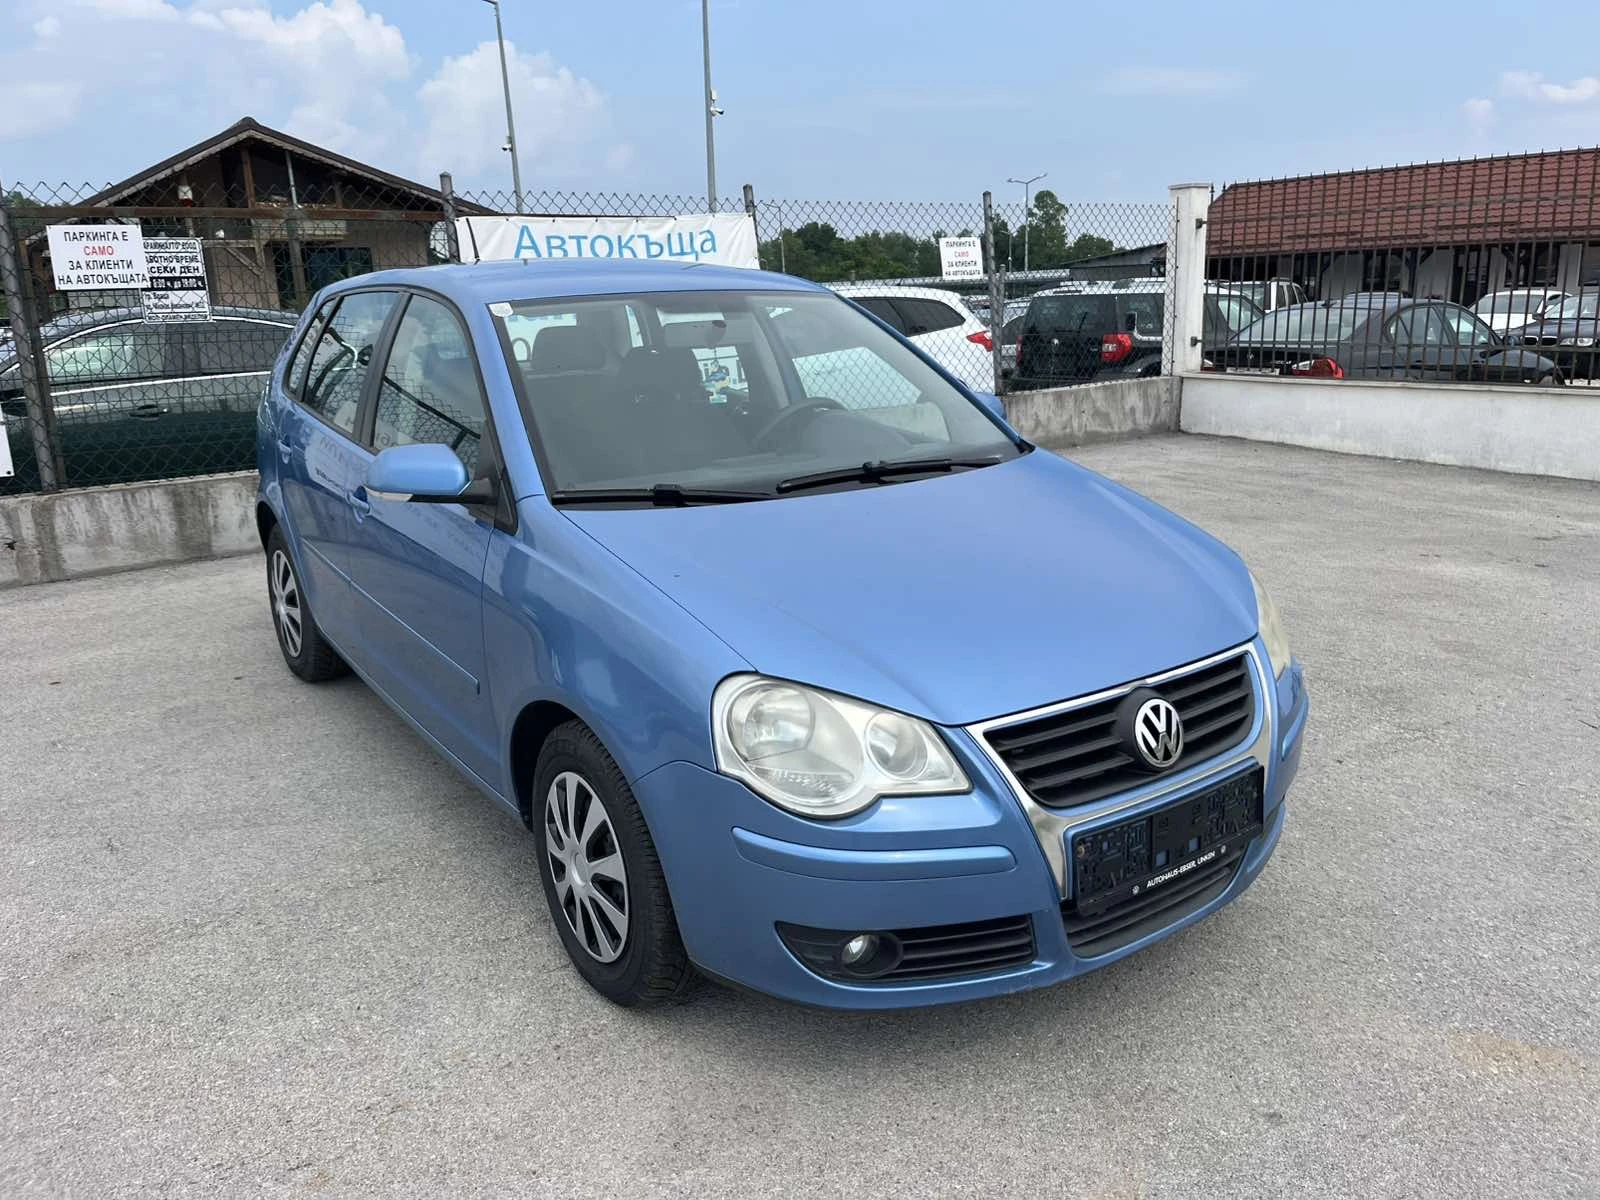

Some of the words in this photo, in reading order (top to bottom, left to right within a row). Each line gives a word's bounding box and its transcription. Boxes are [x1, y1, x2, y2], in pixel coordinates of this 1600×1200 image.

[64, 231, 118, 242] ПАРКИНГА
[122, 231, 129, 241] Е
[513, 224, 718, 261] Автокъща
[945, 240, 972, 248] ПАРКИНГА
[83, 245, 114, 256] САМО
[145, 255, 174, 263] АБОТНО
[69, 260, 83, 271] ЗА
[86, 259, 134, 270] КЛИЕНТИ
[180, 265, 200, 275] ДЕН
[58, 275, 73, 285] НА
[76, 272, 149, 285] АВТОКЪЩАТА
[1135, 698, 1184, 767] VW
